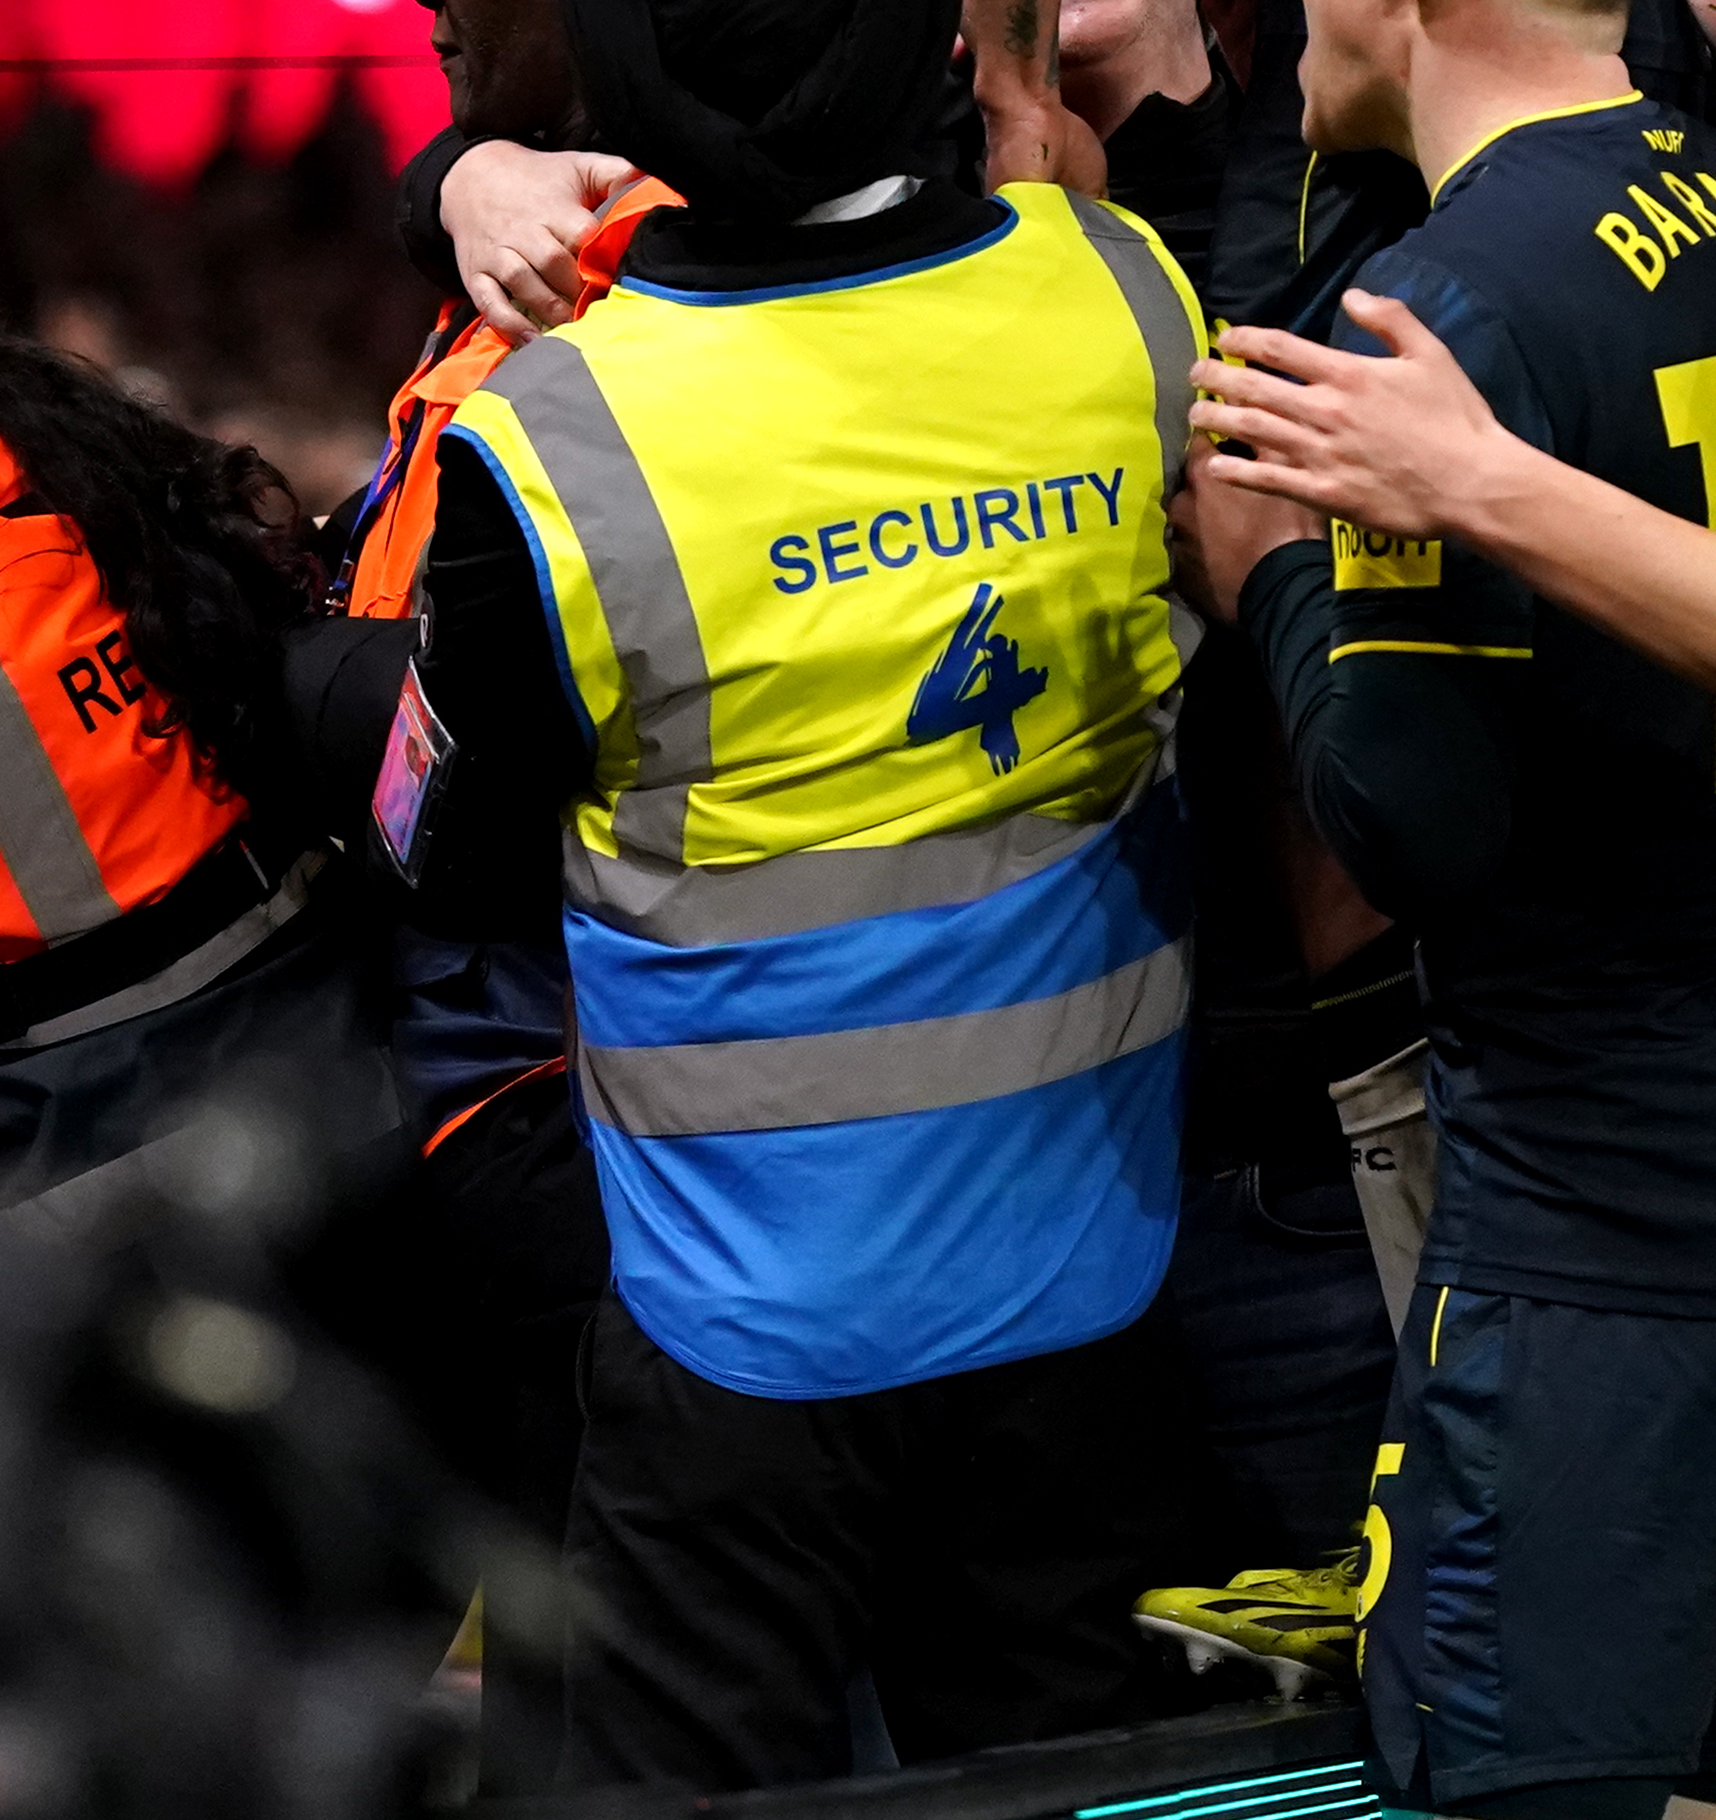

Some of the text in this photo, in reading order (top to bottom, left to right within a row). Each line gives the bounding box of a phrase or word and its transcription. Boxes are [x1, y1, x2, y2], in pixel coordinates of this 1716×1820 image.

[768, 467, 1125, 596] SECURITY
[56, 629, 146, 735] RE
[906, 581, 1049, 777] 4
[1351, 1147, 1397, 1173] FC
[1354, 1442, 1407, 1623] 5
